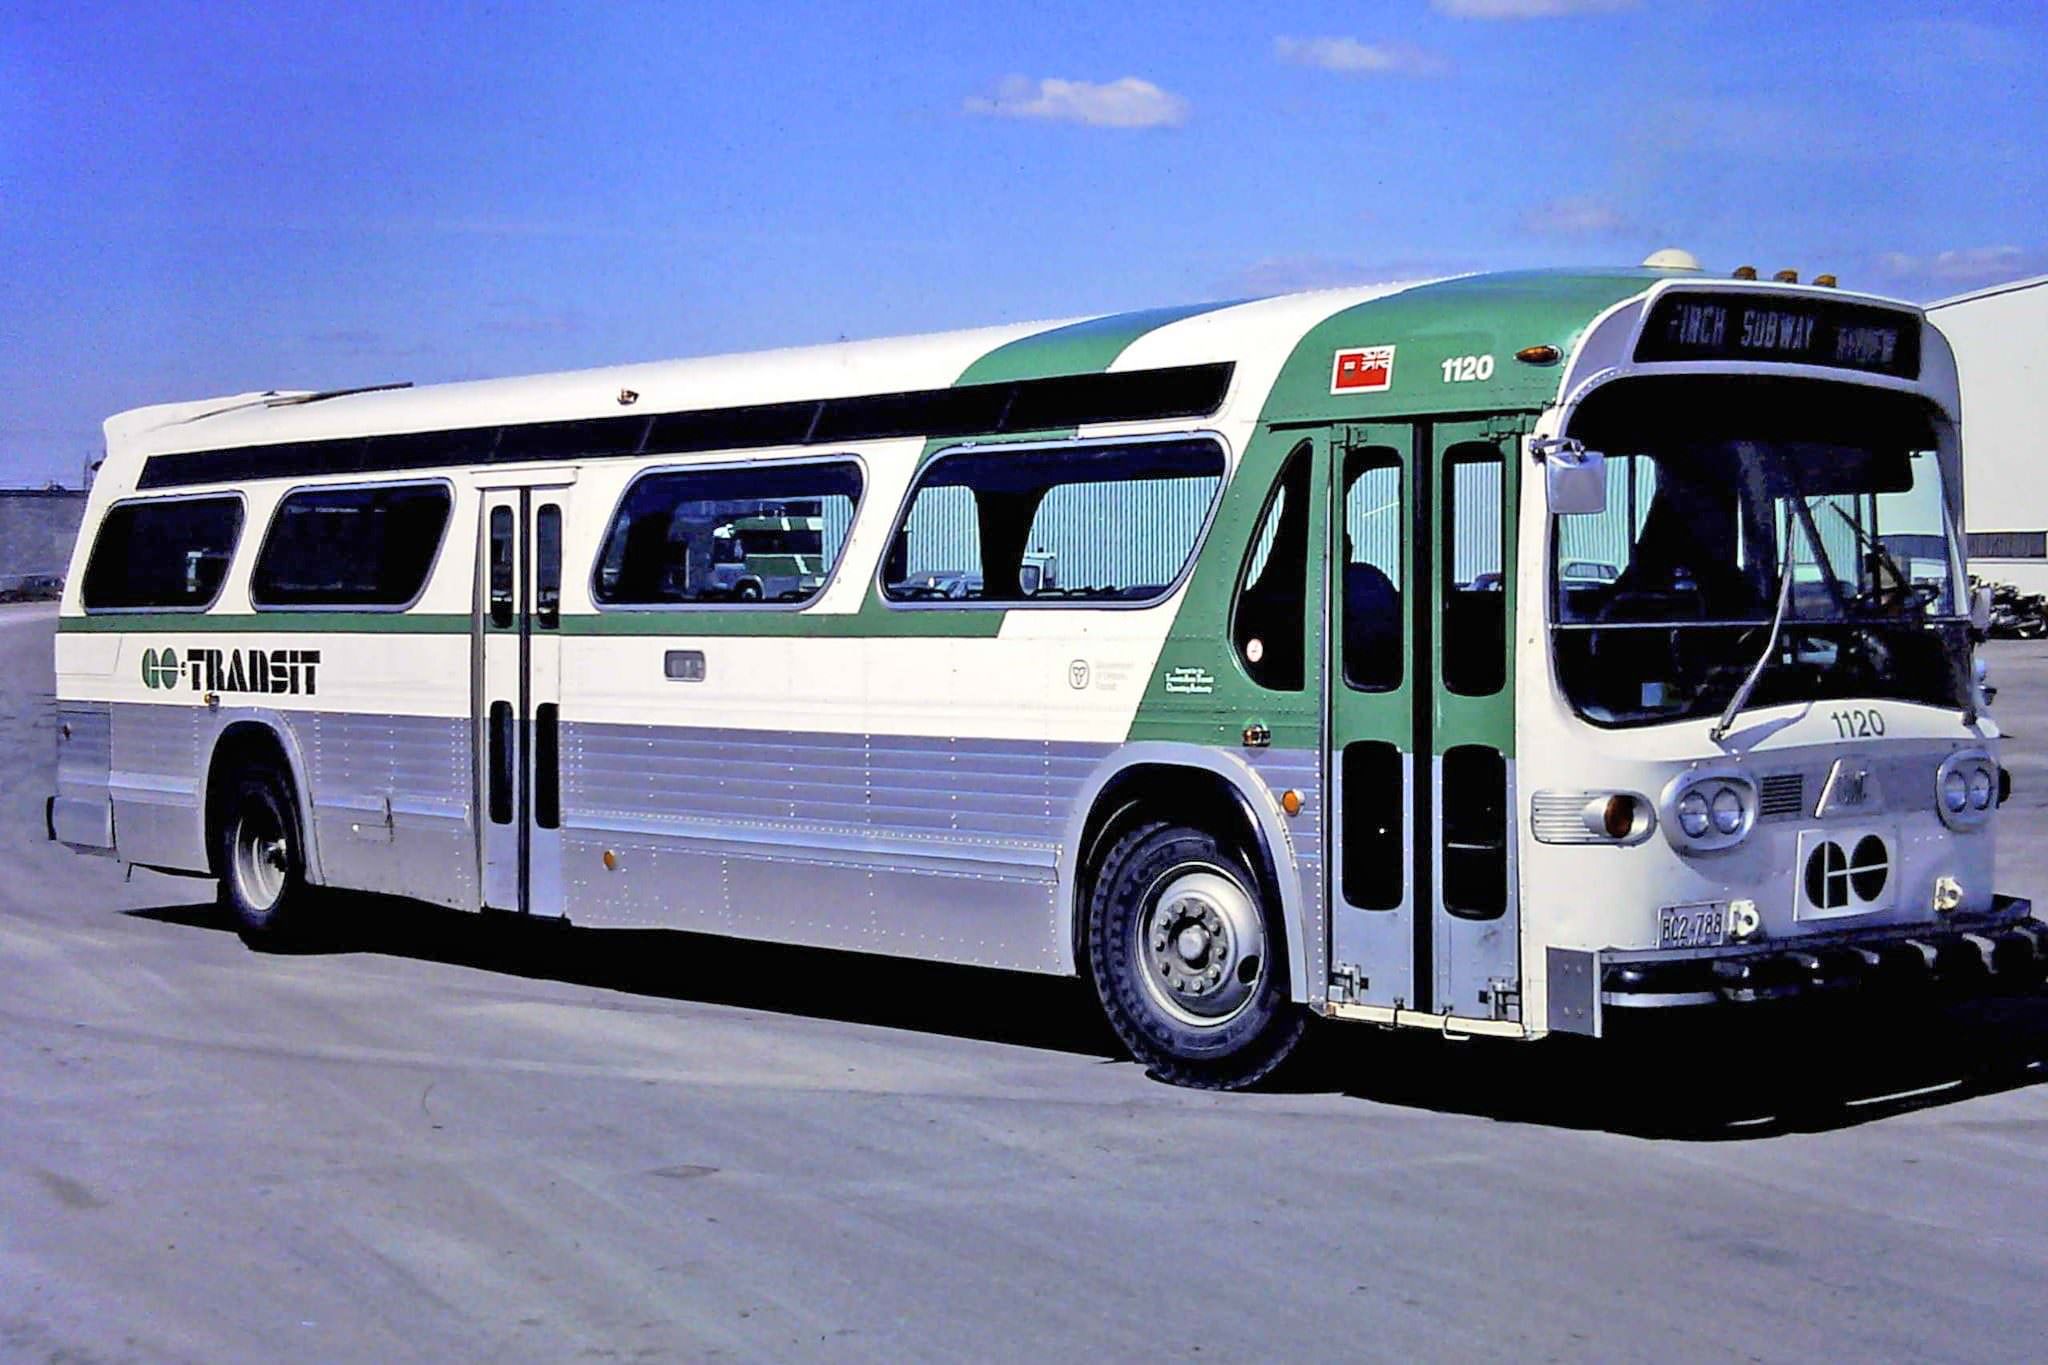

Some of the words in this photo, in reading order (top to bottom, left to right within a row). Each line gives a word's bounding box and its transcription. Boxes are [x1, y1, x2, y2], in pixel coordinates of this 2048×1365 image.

[1741, 309, 1814, 350] SUBWAY
[1442, 355, 1495, 382] 1120
[187, 648, 320, 695] TRANSIT
[1831, 709, 1886, 738] 1120
